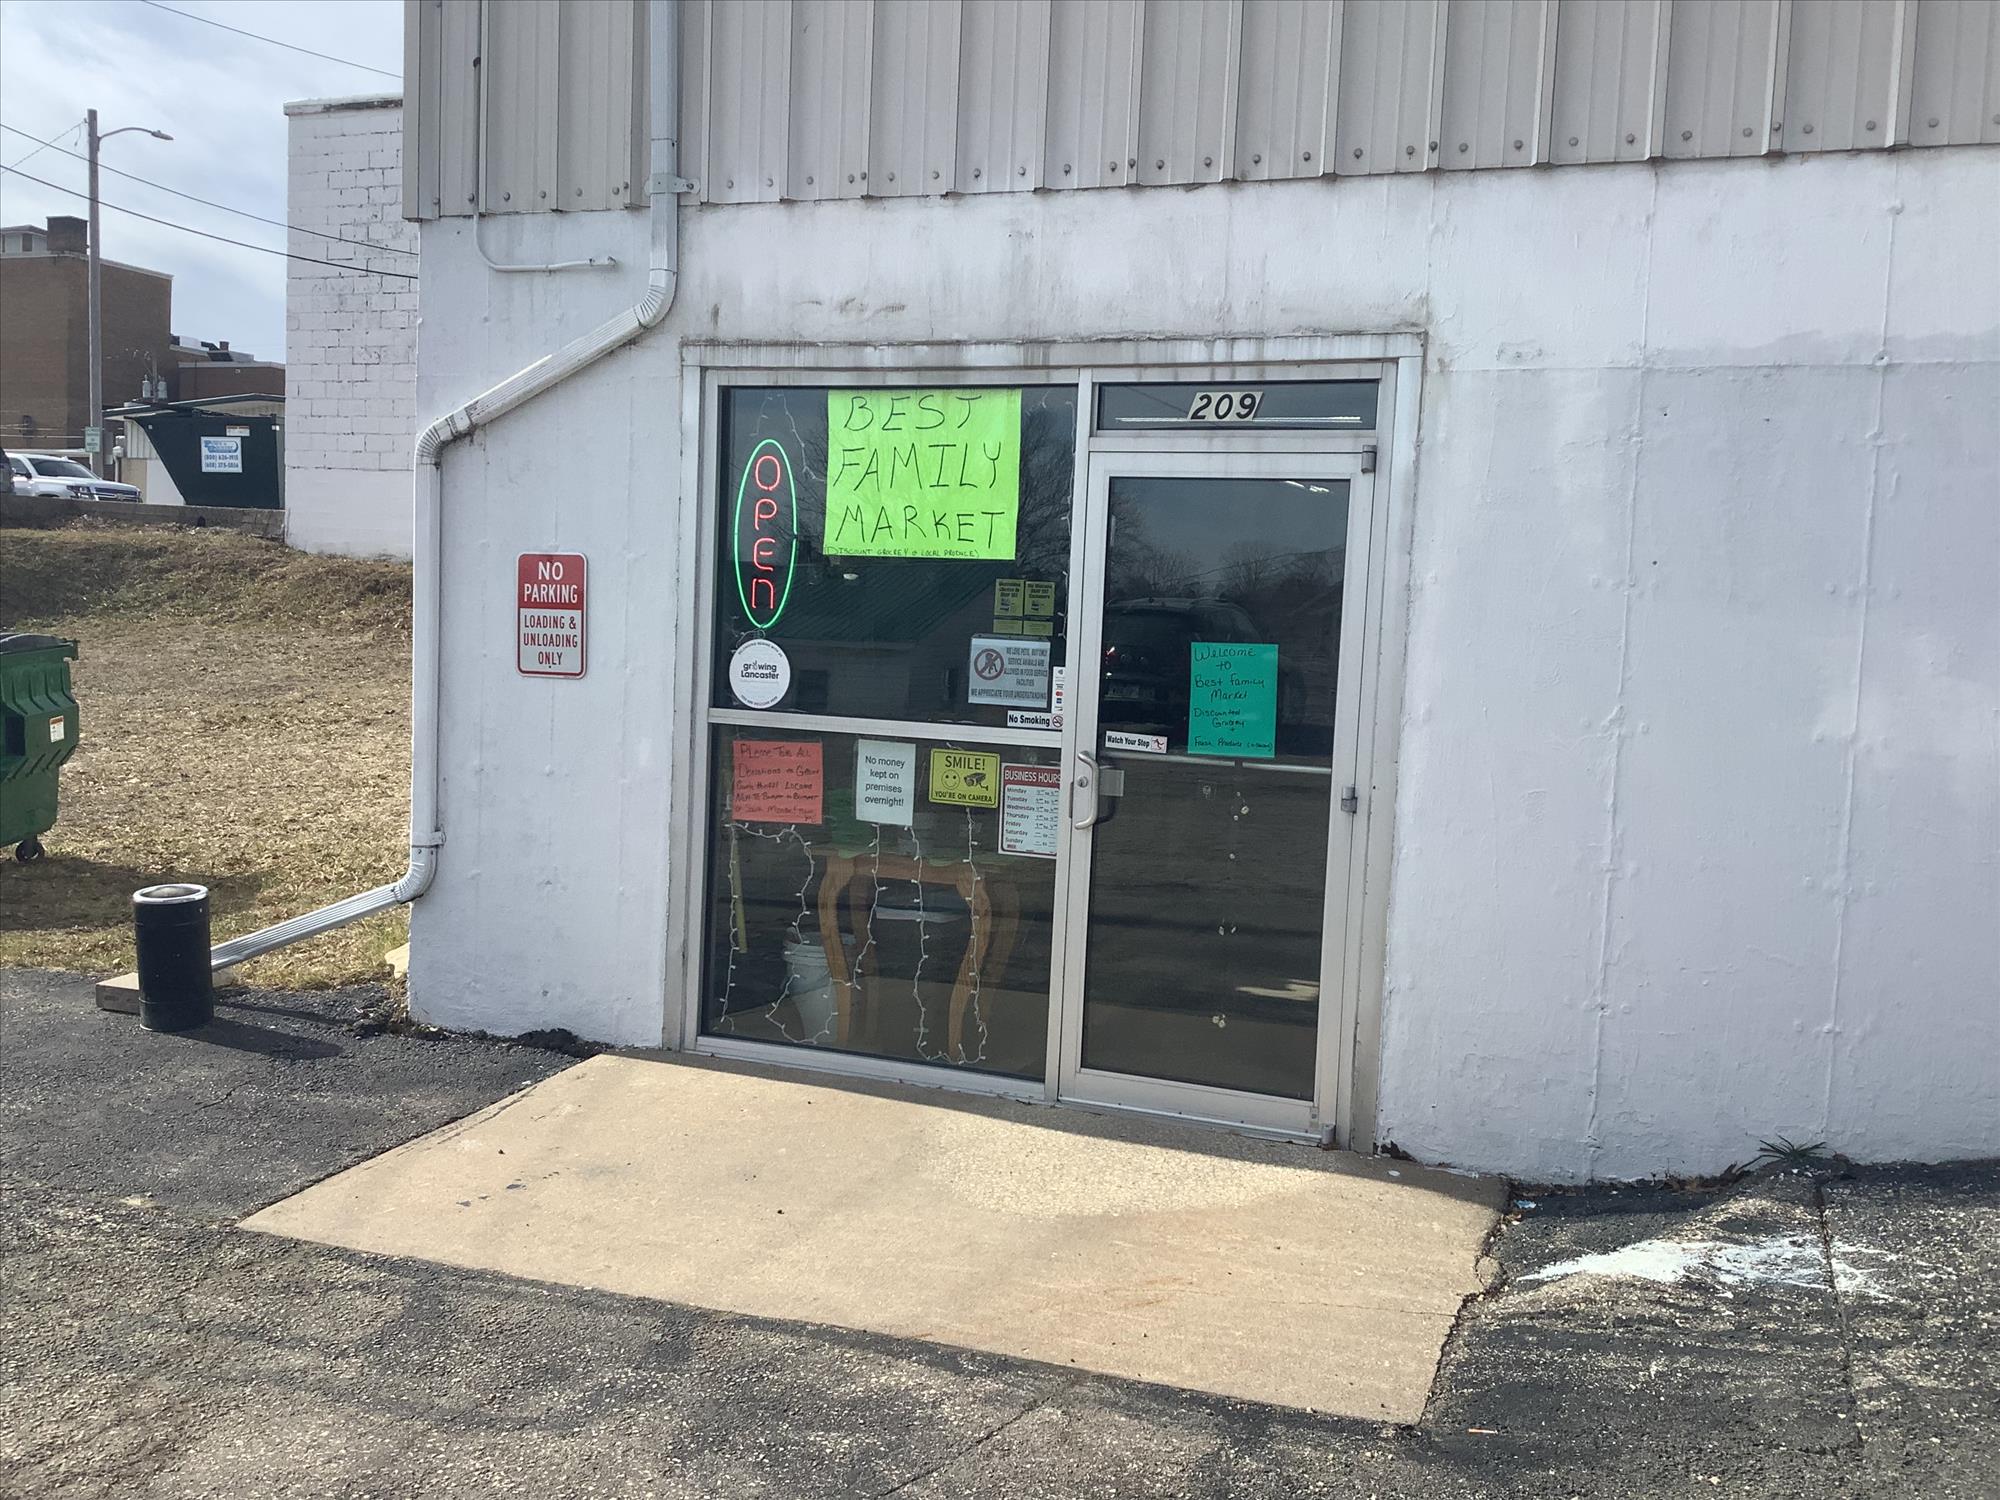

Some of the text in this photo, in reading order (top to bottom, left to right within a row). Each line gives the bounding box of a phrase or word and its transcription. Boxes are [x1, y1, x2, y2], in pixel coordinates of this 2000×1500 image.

[844, 394, 982, 431] BEST
[1190, 394, 1258, 420] 209
[832, 441, 1002, 492] FAMILY
[835, 504, 1006, 549] MARKET
[538, 561, 564, 580] NO
[524, 583, 578, 604] PARKING
[524, 614, 576, 630] LOADING &
[523, 632, 578, 648] UNLOADING
[538, 651, 563, 665] ONLY
[1216, 662, 1231, 671] to
[741, 670, 779, 680] Lancaster
[1009, 714, 1050, 727] No Smoking
[1107, 736, 1150, 748] Watch Your Step
[865, 755, 905, 769] No money
[945, 755, 986, 770] SMILE!
[870, 769, 887, 779] kept
[1004, 770, 1037, 782] BUSINESS
[865, 783, 902, 793] premises
[864, 796, 904, 807] overnight!
[935, 791, 955, 799] YOU'RE
[968, 794, 993, 802] CAMERA
